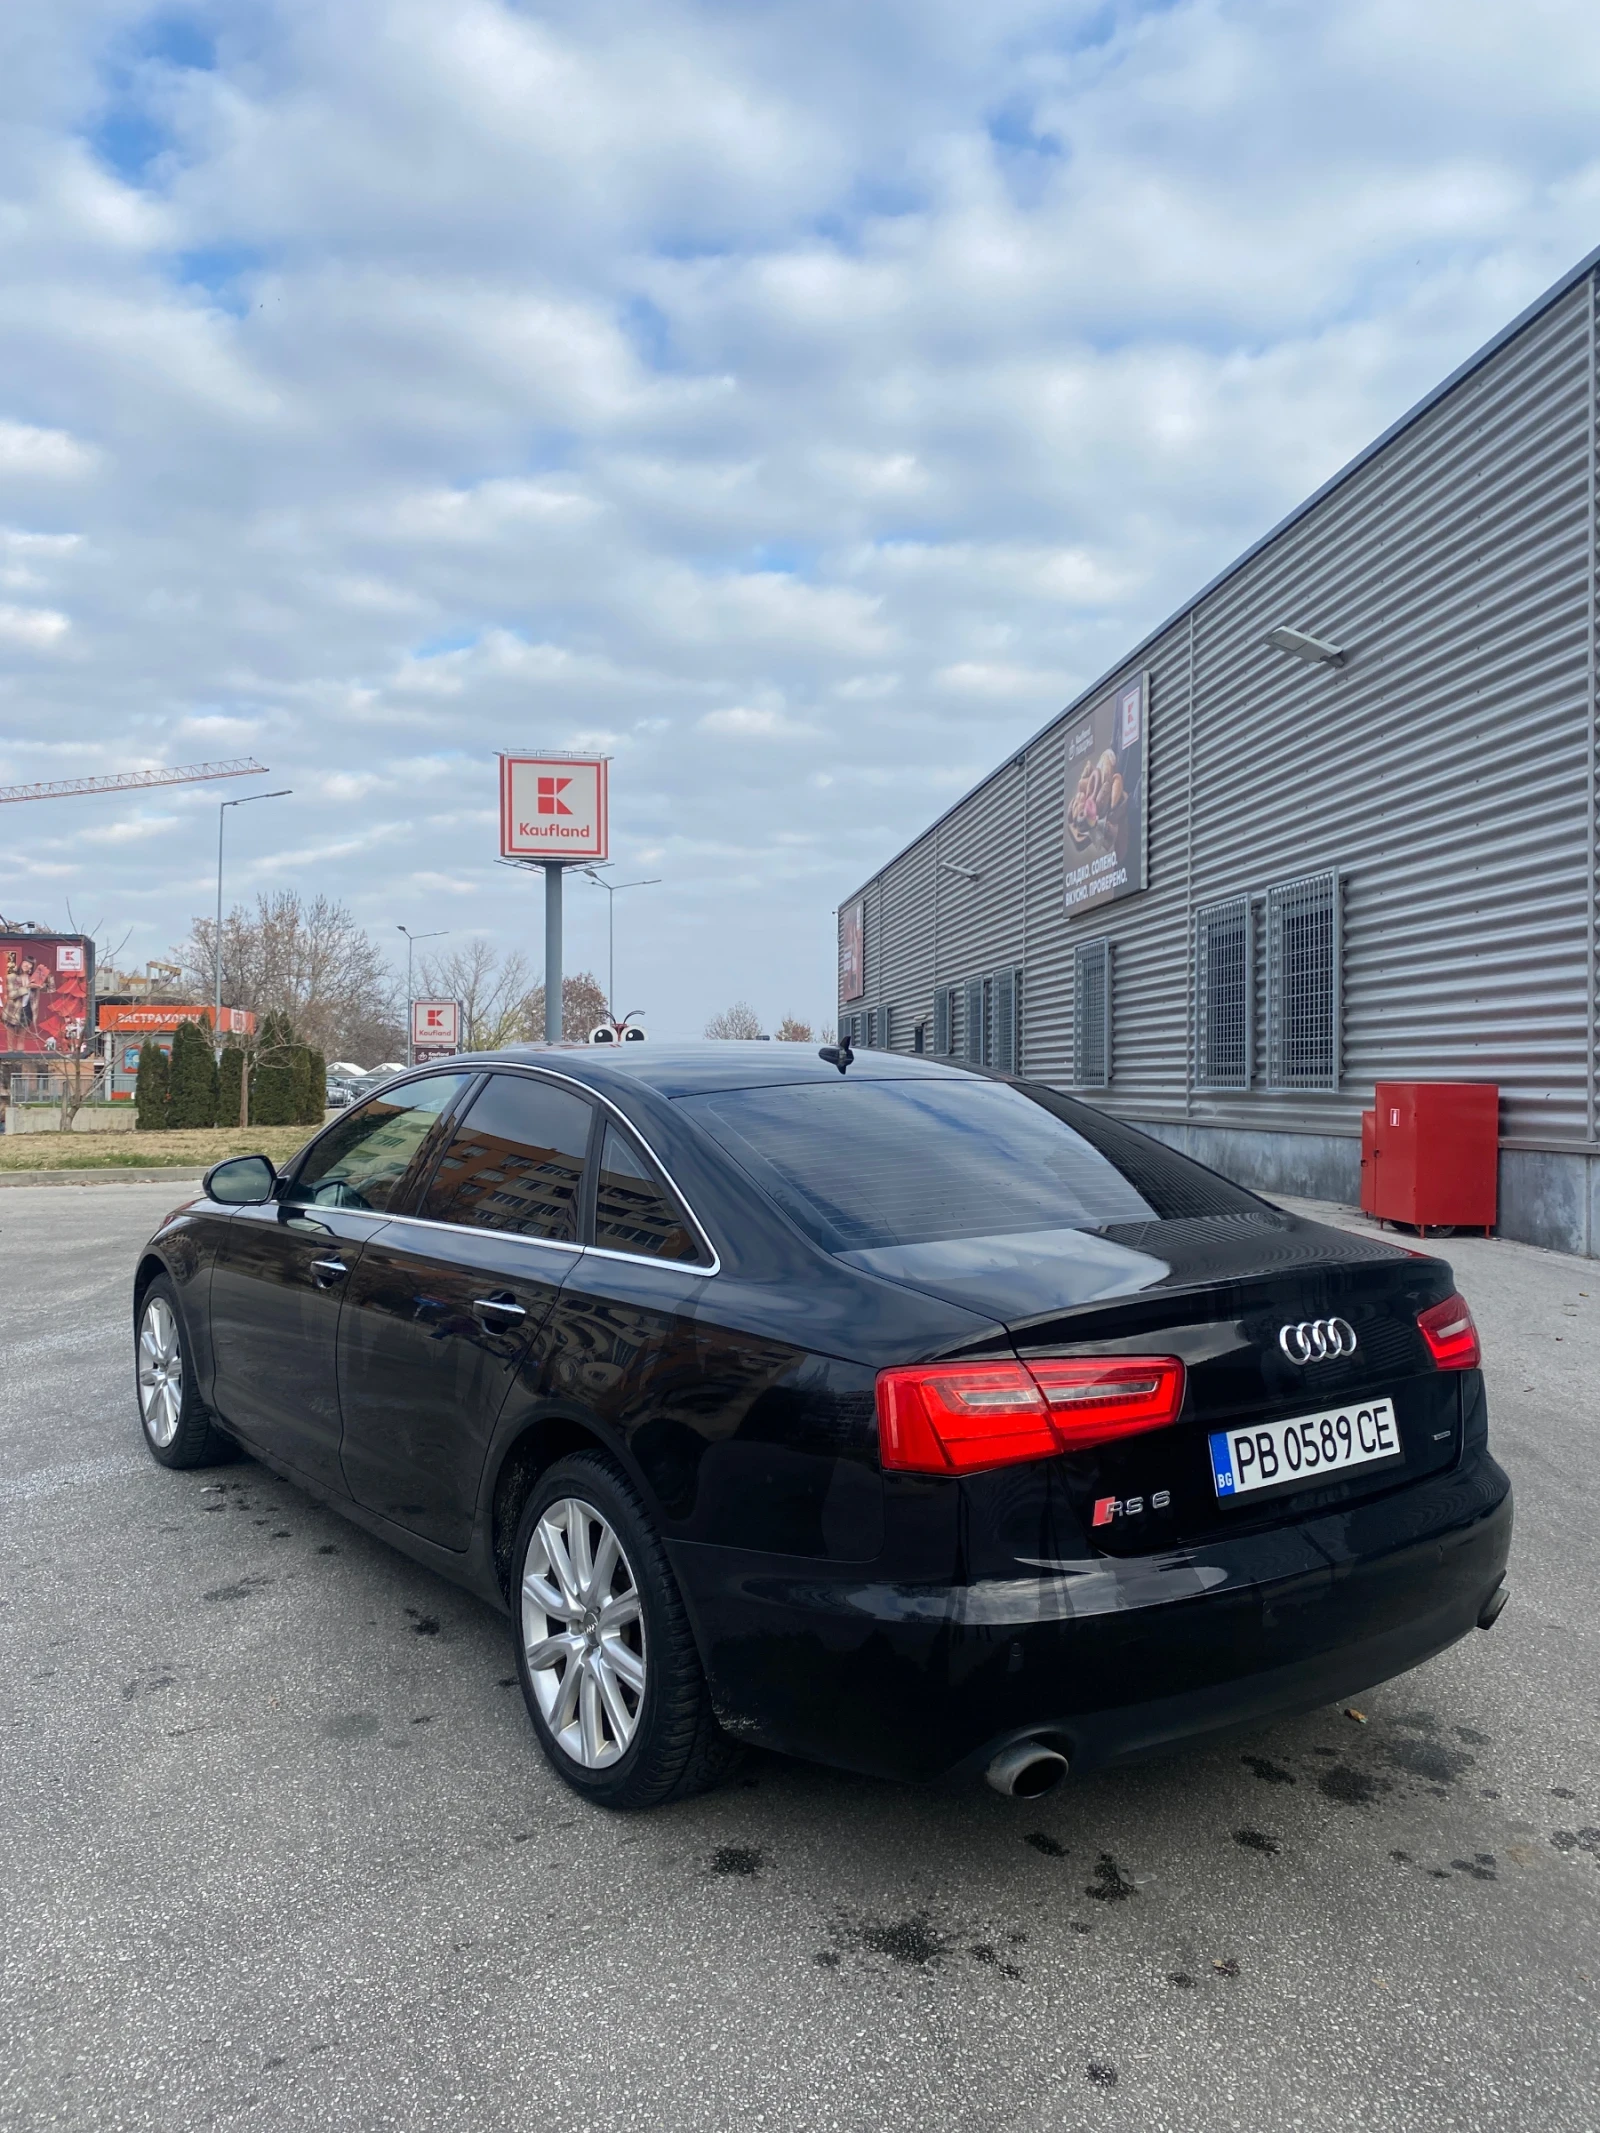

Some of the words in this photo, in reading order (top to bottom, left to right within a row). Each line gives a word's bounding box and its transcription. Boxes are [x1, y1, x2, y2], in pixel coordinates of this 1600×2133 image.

[519, 822, 590, 837] Kaufland
[1091, 851, 1118, 875] СОЛЕНО.
[1089, 867, 1128, 897] ПРОВЕРЕНО.
[419, 1029, 451, 1037] Kaufland
[1217, 1472, 1233, 1489] BG
[1234, 1432, 1279, 1485] PB
[1284, 1415, 1353, 1471] 0589
[1357, 1405, 1394, 1454] CE
[1104, 1496, 1144, 1520] RS
[1152, 1490, 1171, 1509] 6
